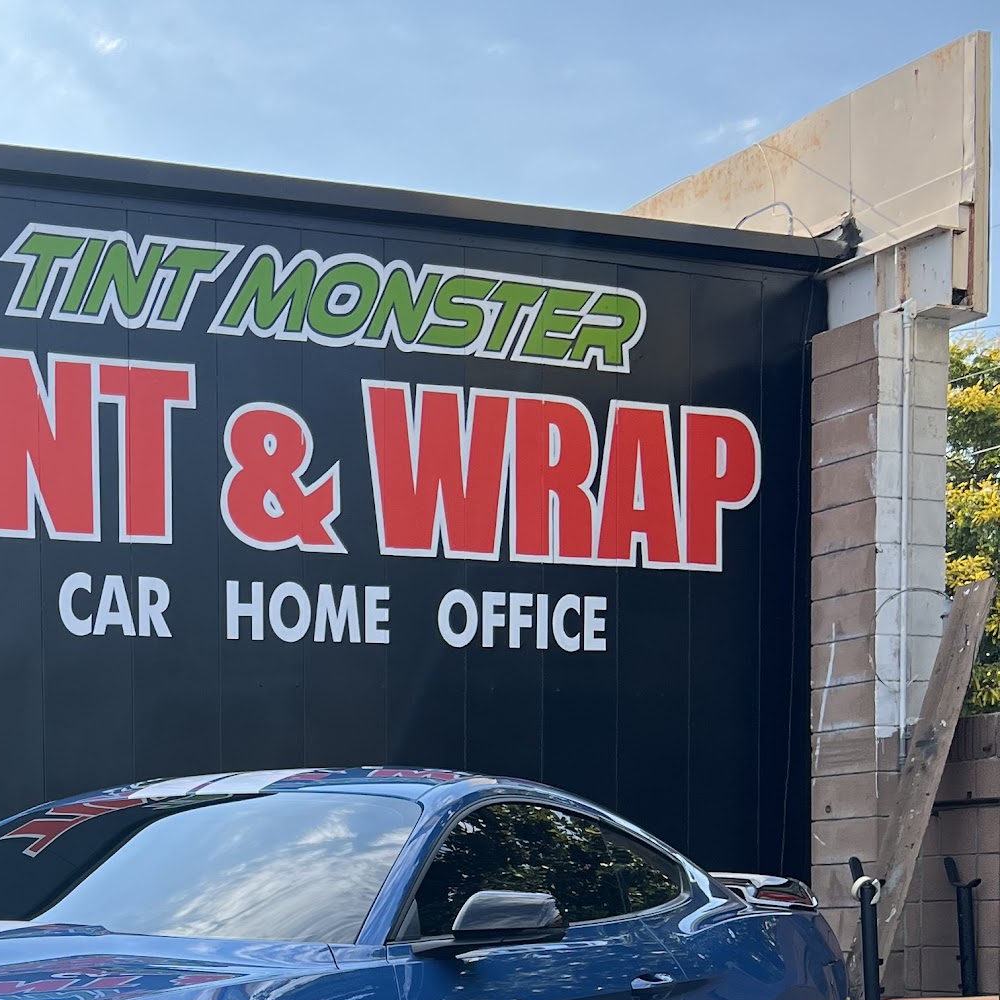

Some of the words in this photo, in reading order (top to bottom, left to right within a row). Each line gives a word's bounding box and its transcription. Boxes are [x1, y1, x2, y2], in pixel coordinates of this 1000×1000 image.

[0, 223, 244, 330] TINT
[207, 245, 646, 373] MONSTER
[221, 402, 347, 553] &
[362, 379, 761, 571] WRAP
[58, 572, 172, 637] CAR
[226, 580, 390, 644] HOME
[438, 588, 607, 651] OFFICE
